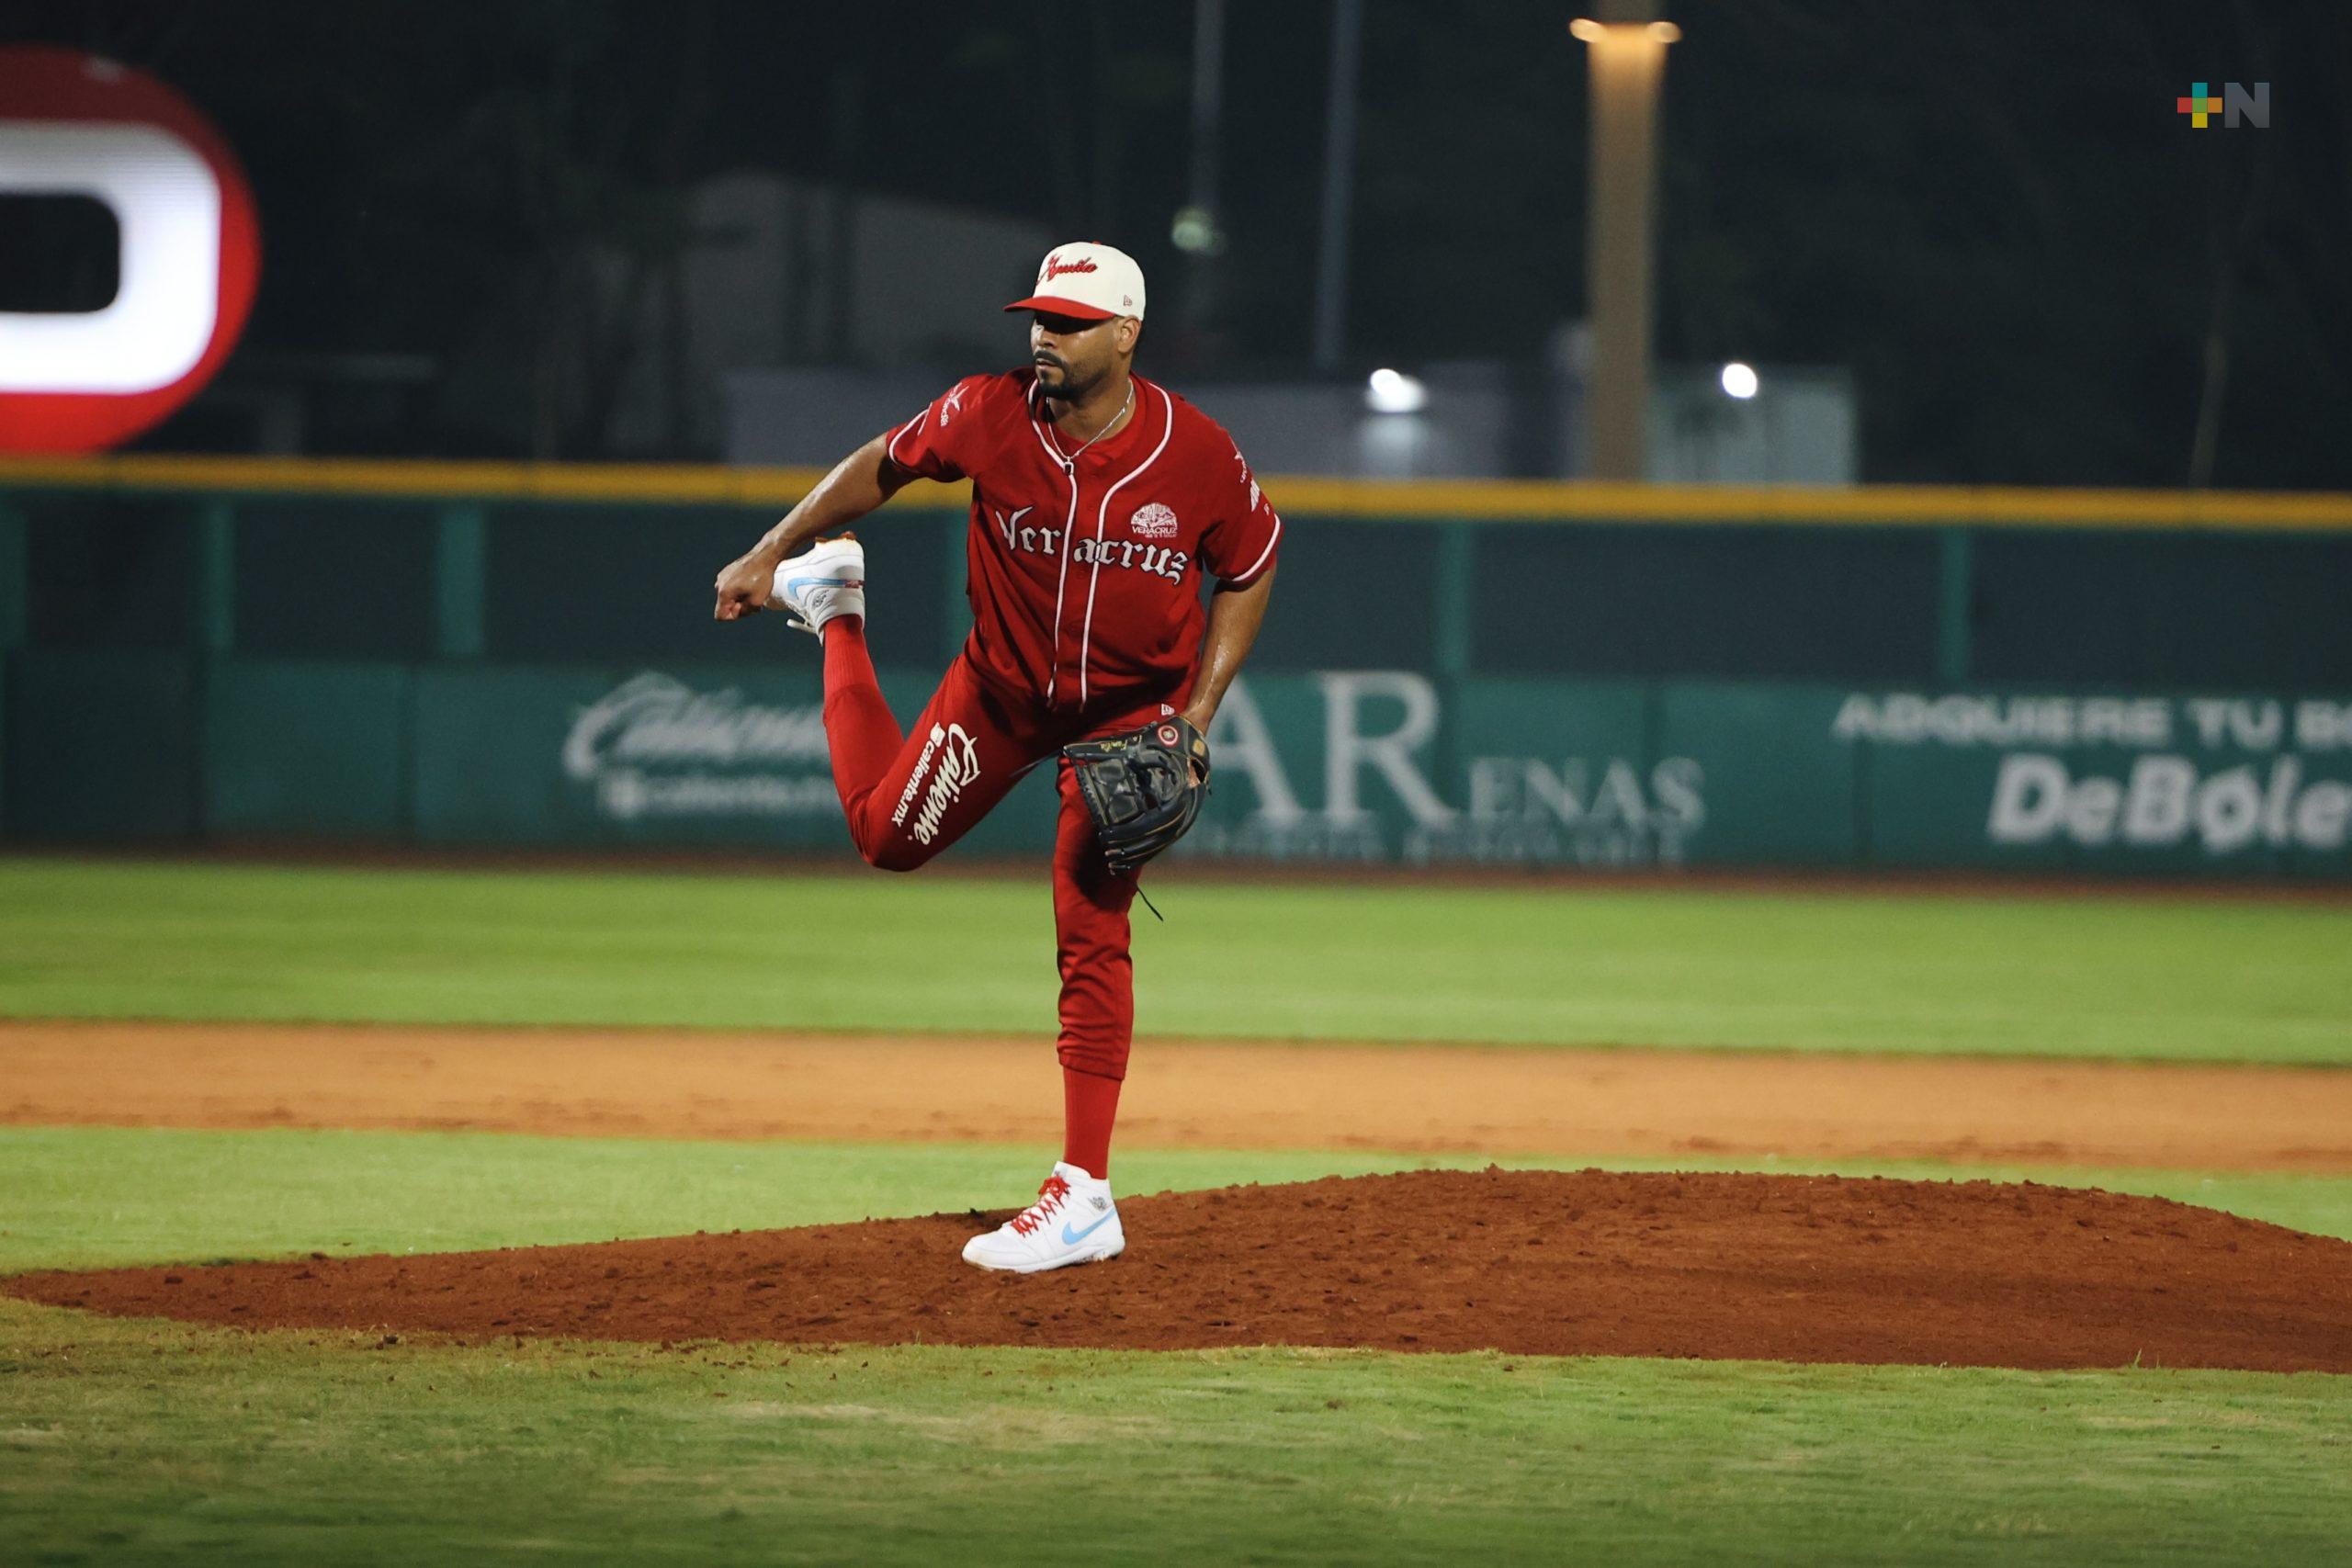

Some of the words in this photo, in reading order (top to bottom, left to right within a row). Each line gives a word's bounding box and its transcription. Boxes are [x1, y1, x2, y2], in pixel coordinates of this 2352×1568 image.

[1131, 525, 1177, 535] VERACRUZ
[1832, 693, 2172, 748] ADQUIERE
[2184, 697, 2285, 750] TU
[891, 739, 935, 828] caliente.mx
